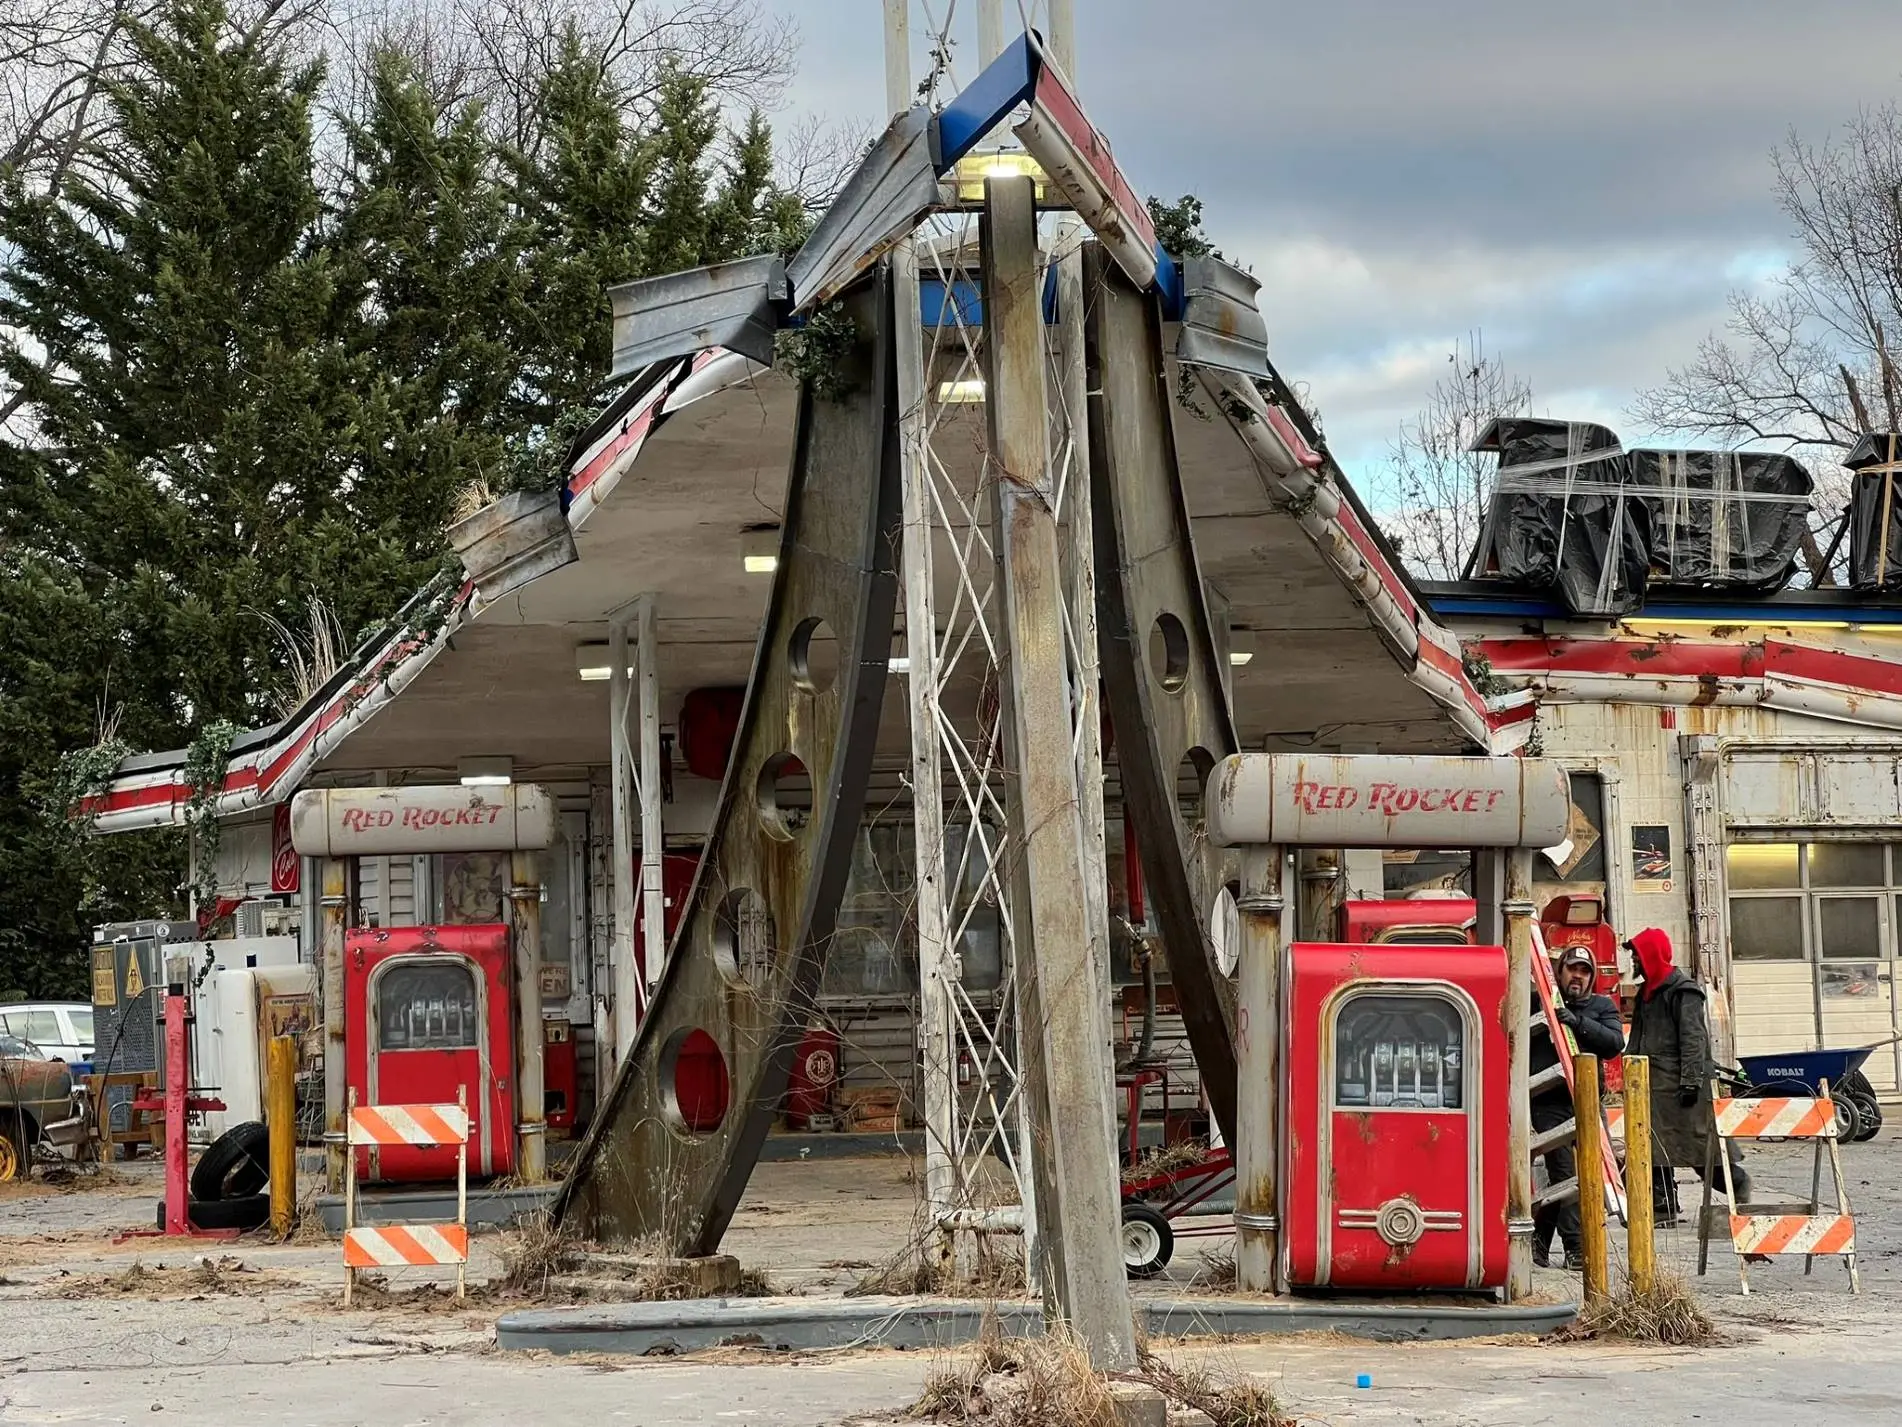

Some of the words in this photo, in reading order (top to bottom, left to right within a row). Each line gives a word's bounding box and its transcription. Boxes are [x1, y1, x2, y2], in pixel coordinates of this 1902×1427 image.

[1292, 781, 1358, 815] RED
[1368, 783, 1504, 816] ROCKET
[342, 807, 394, 833] RED
[402, 804, 503, 831] ROCKET
[1403, 1047, 1411, 1058] 3
[1427, 1052, 1435, 1063] 2
[1766, 1067, 1805, 1077] KOBALT
